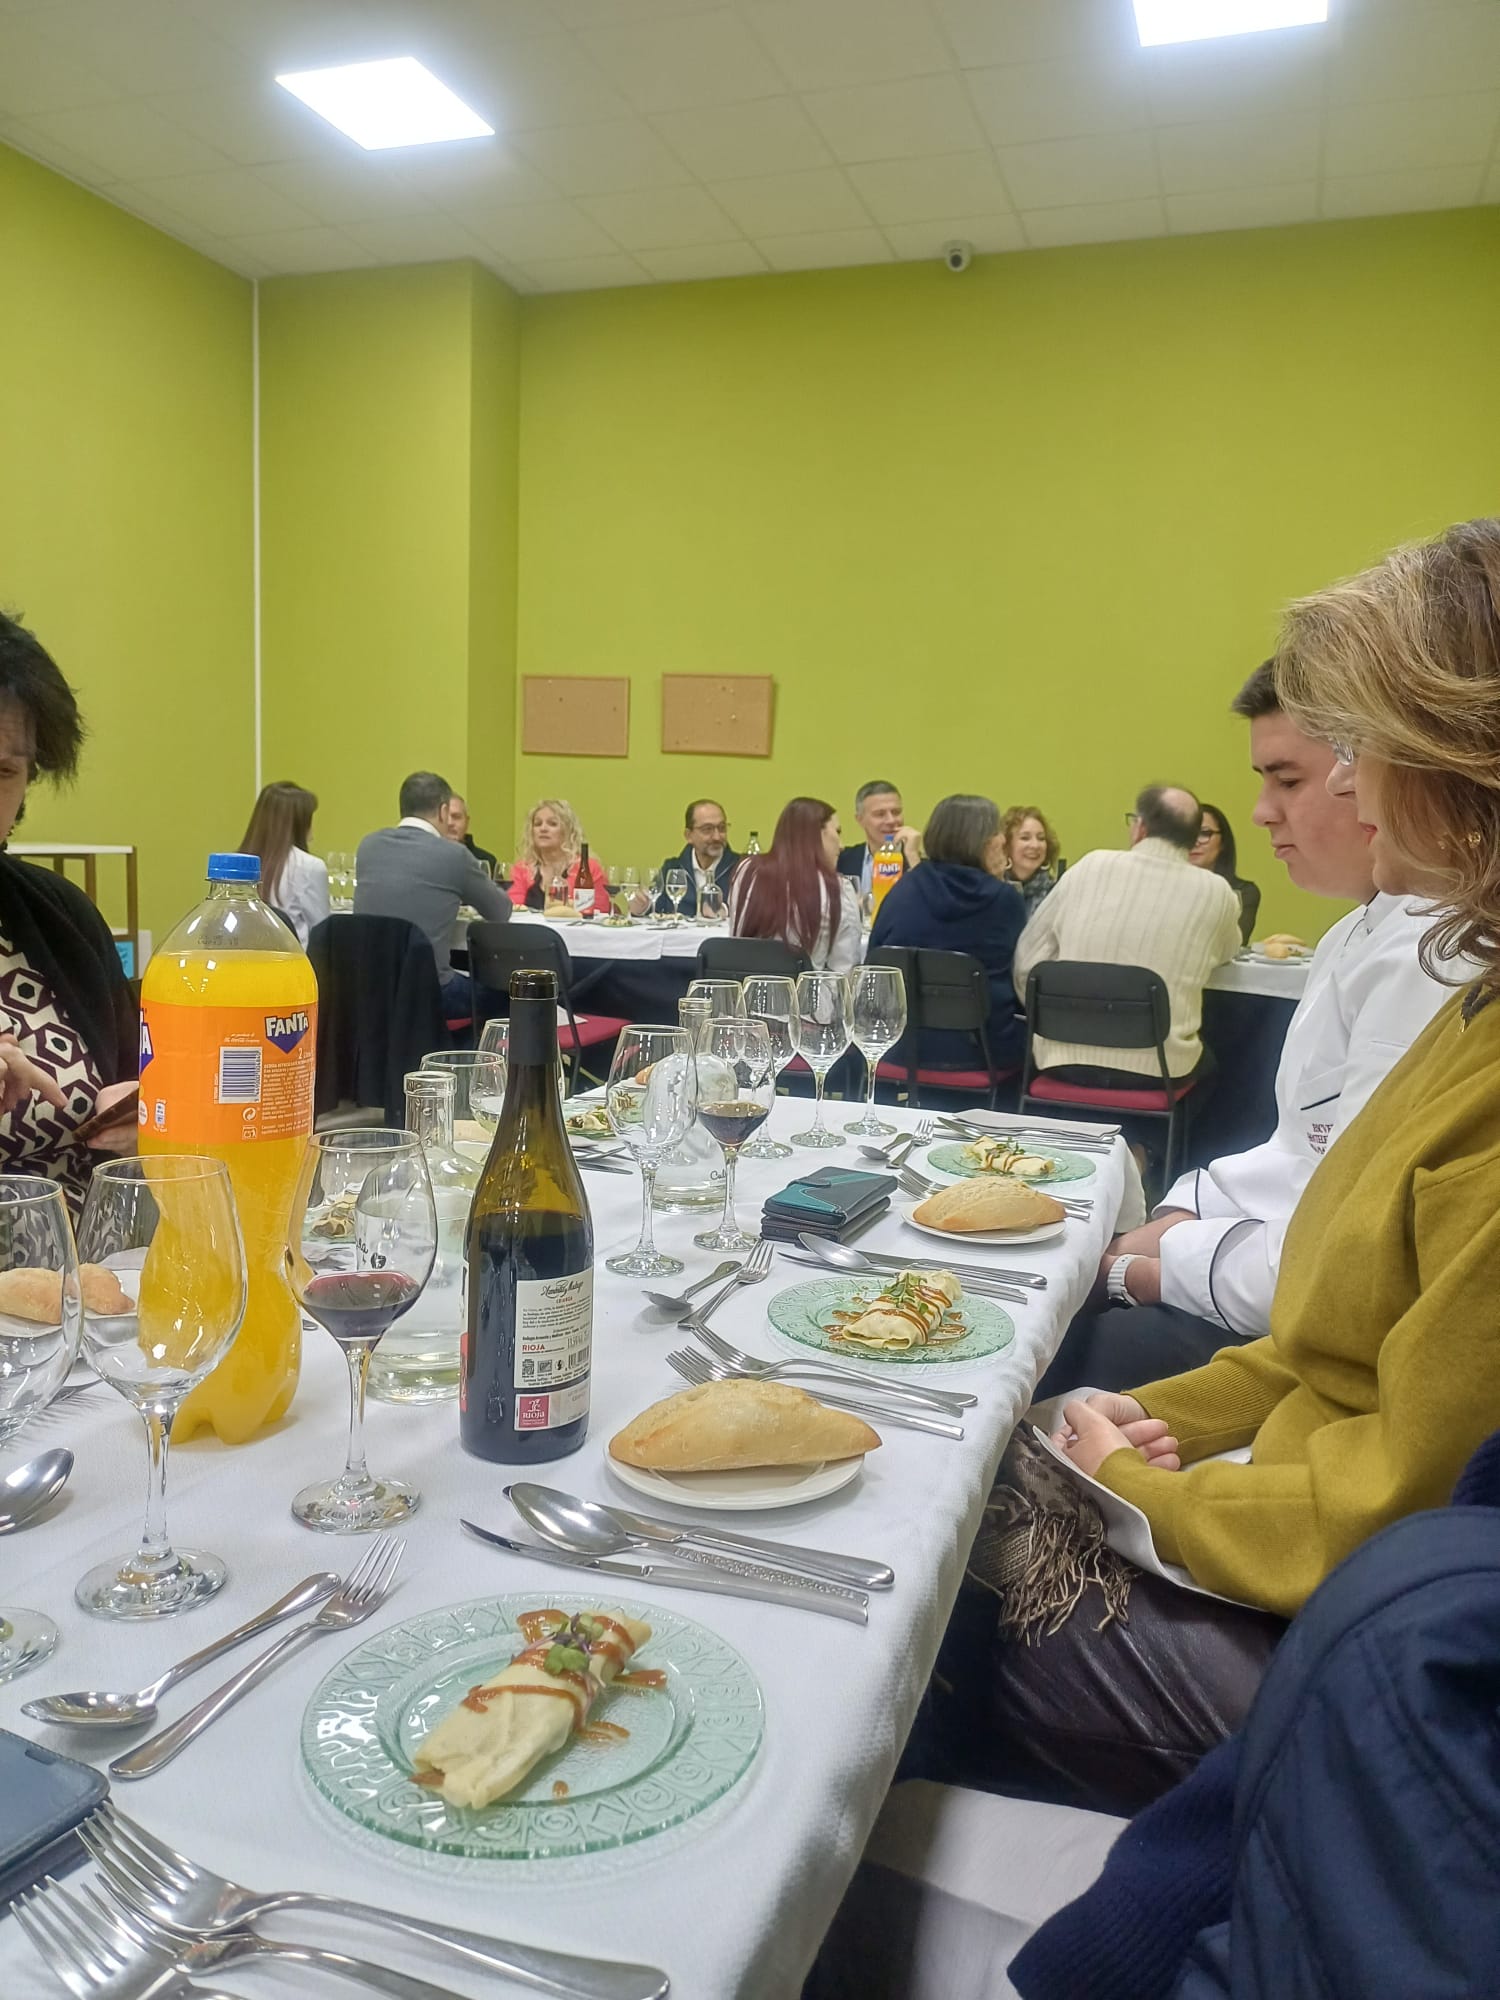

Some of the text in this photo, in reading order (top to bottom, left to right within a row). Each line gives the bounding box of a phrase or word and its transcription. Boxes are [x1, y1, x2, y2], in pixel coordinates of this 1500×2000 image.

[265, 1011, 309, 1037] FANTA
[522, 1343, 546, 1351] RIOJA
[522, 1410, 545, 1419] RIOJA
